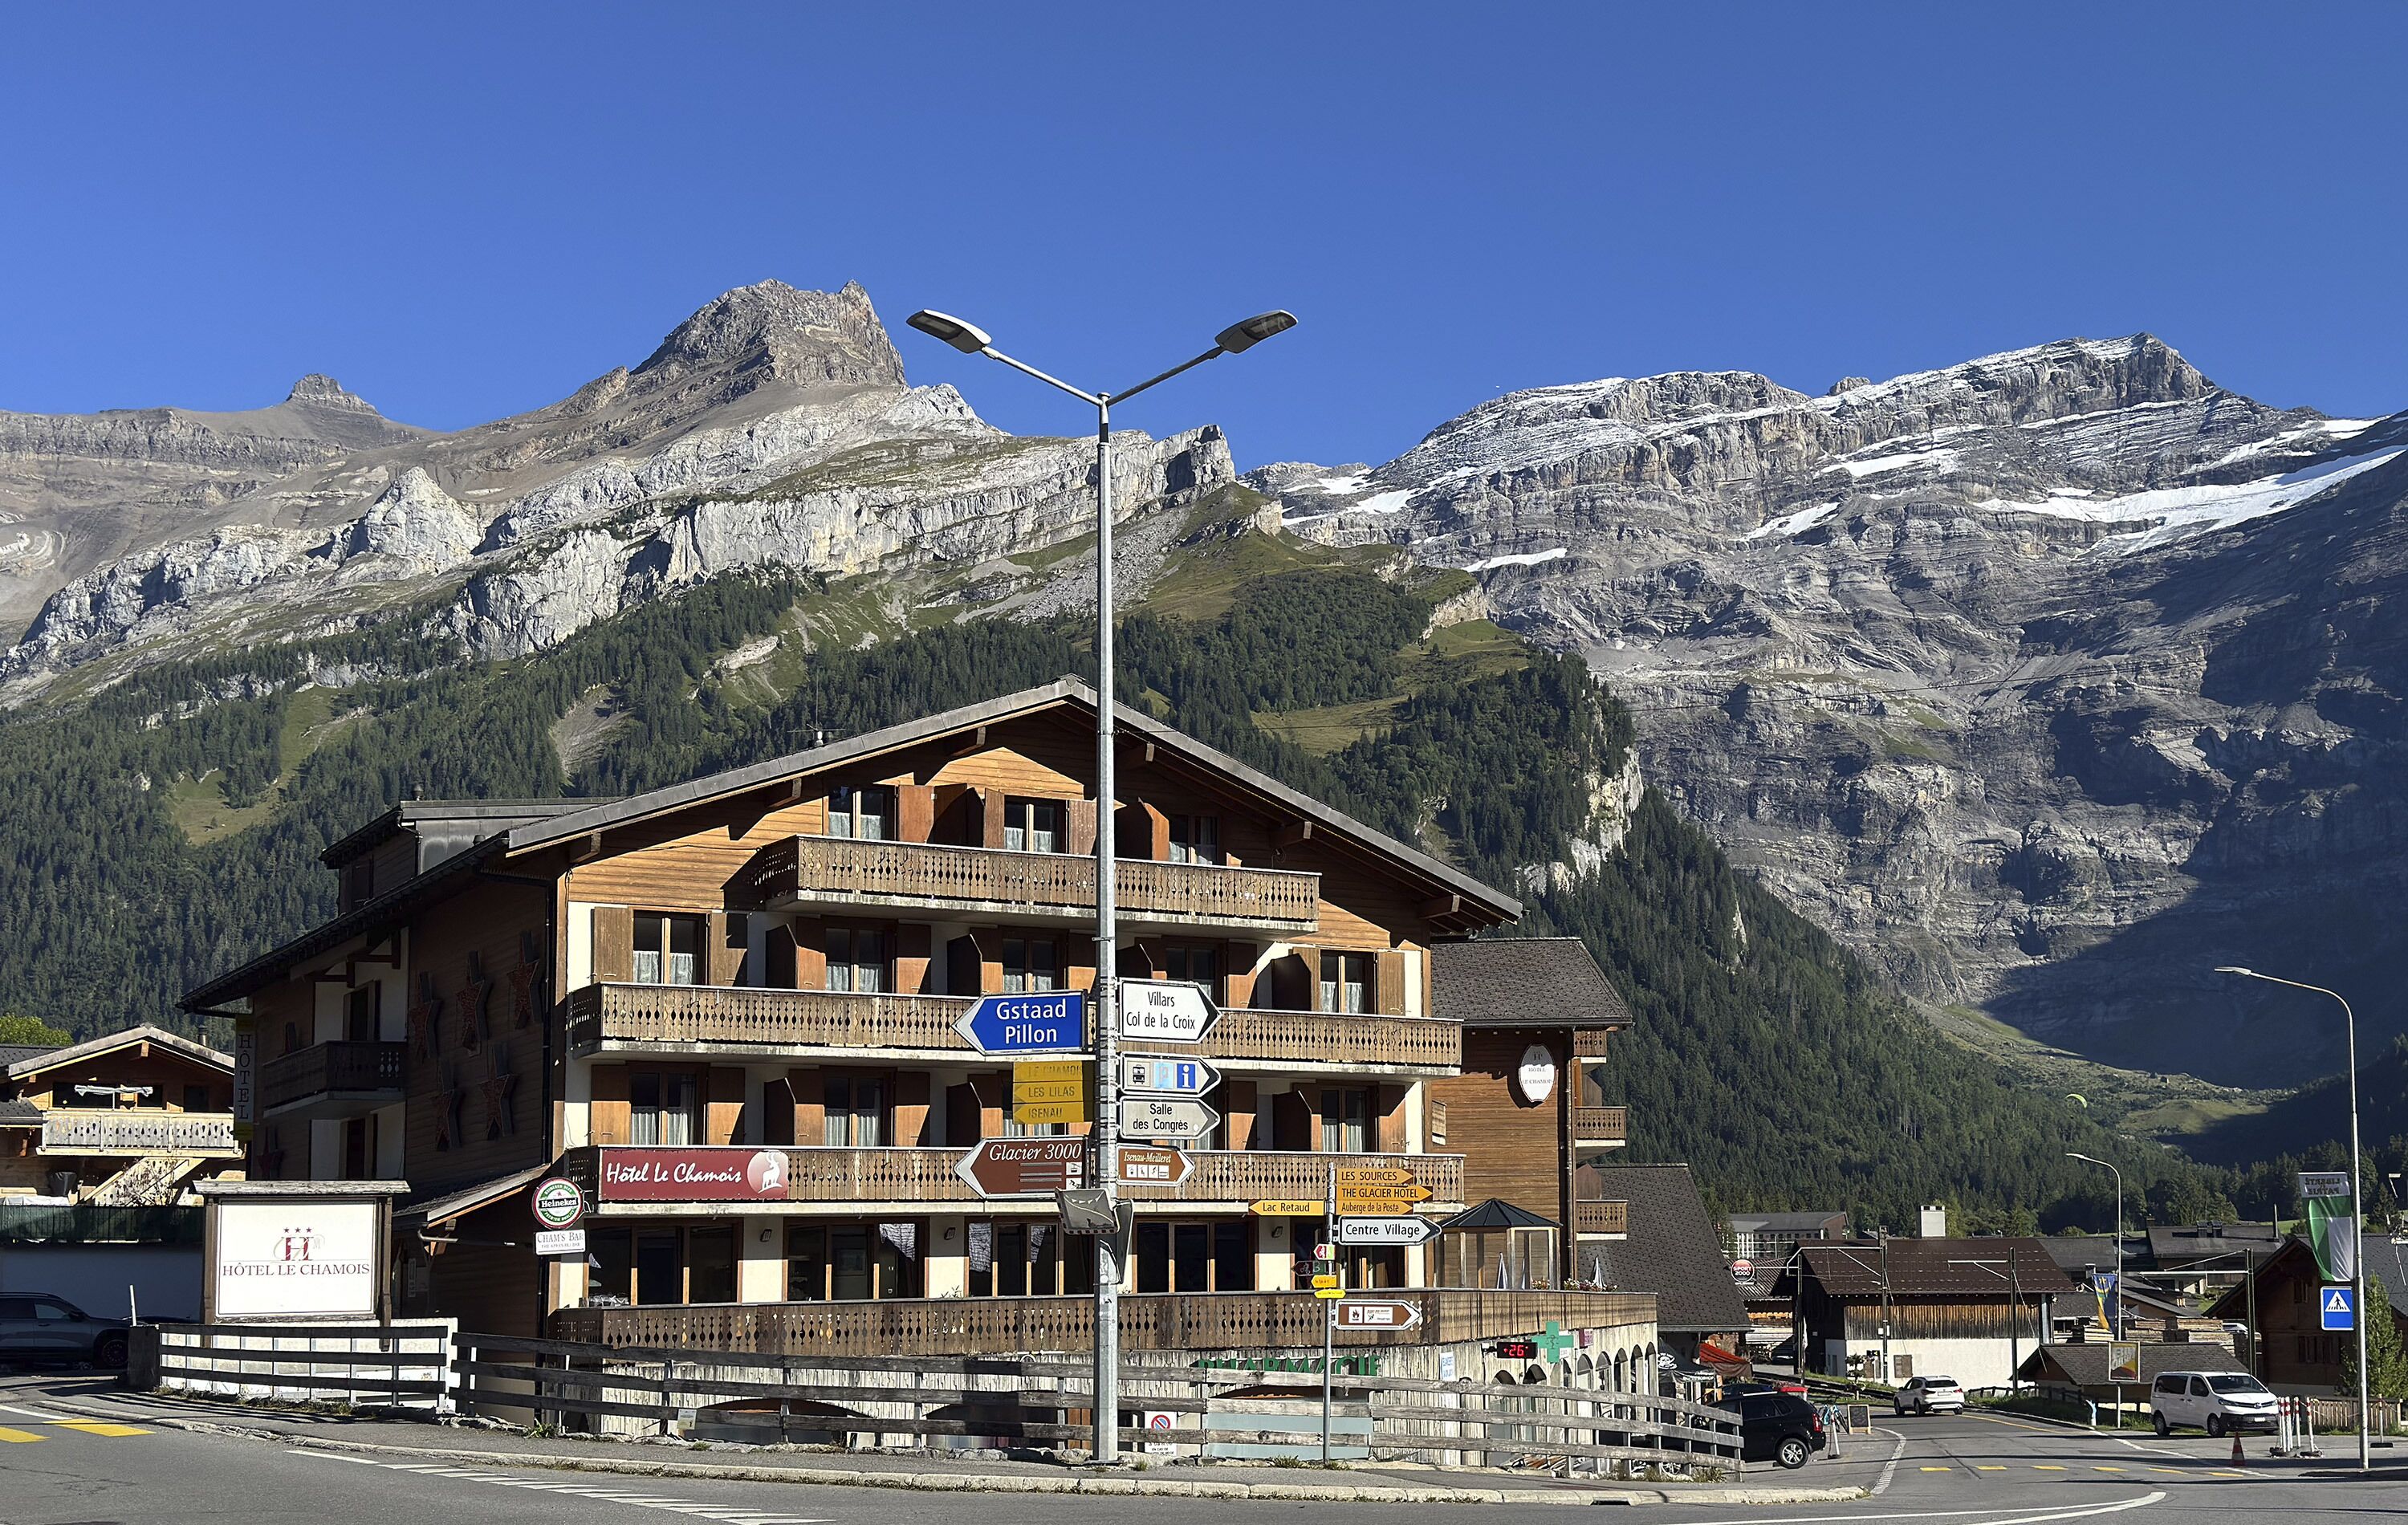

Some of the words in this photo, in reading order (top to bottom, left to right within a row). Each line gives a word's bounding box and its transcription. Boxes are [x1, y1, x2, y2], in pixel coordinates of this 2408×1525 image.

[1148, 991, 1174, 1007] Villars
[996, 998, 1066, 1020] Gstaad
[1126, 1011, 1140, 1026] Col
[1145, 1012, 1156, 1027] de
[1160, 1013, 1169, 1028] la
[1173, 1015, 1195, 1029] Croix
[1005, 1024, 1057, 1044] Pillon
[238, 1034, 251, 1120] HÔTEL
[1028, 1087, 1044, 1098] LES
[1049, 1086, 1075, 1097] LILAS
[1028, 1108, 1062, 1119] ISENAU
[1149, 1103, 1172, 1115] Salle
[1133, 1118, 1149, 1129] des
[1153, 1118, 1188, 1133] Congrès
[989, 1144, 1042, 1161] Glacier
[1045, 1143, 1081, 1160] 3000
[606, 1162, 649, 1184] Hôtel
[654, 1162, 669, 1183] Le
[673, 1162, 742, 1183] Chamois
[1341, 1171, 1355, 1181] LES
[1360, 1171, 1397, 1181] SOURCES
[1341, 1188, 1356, 1198] THE
[1359, 1188, 1392, 1198] GLACIER
[1394, 1189, 1418, 1198] HOTEL
[541, 1198, 577, 1208] Heineken
[1263, 1202, 1276, 1211] Lac
[1280, 1202, 1310, 1212] Retaud
[1341, 1202, 1366, 1214] Auberge
[1367, 1202, 1374, 1212] de
[1377, 1202, 1381, 1212] la
[1383, 1203, 1399, 1212] Poste
[538, 1232, 565, 1243] CHAM'S
[569, 1231, 584, 1242] BAR
[1346, 1224, 1379, 1235] Centre
[1385, 1223, 1420, 1238] Village
[222, 1263, 275, 1276] HÔTEL
[278, 1265, 296, 1275] LE
[300, 1263, 370, 1275] CHAMOIS
